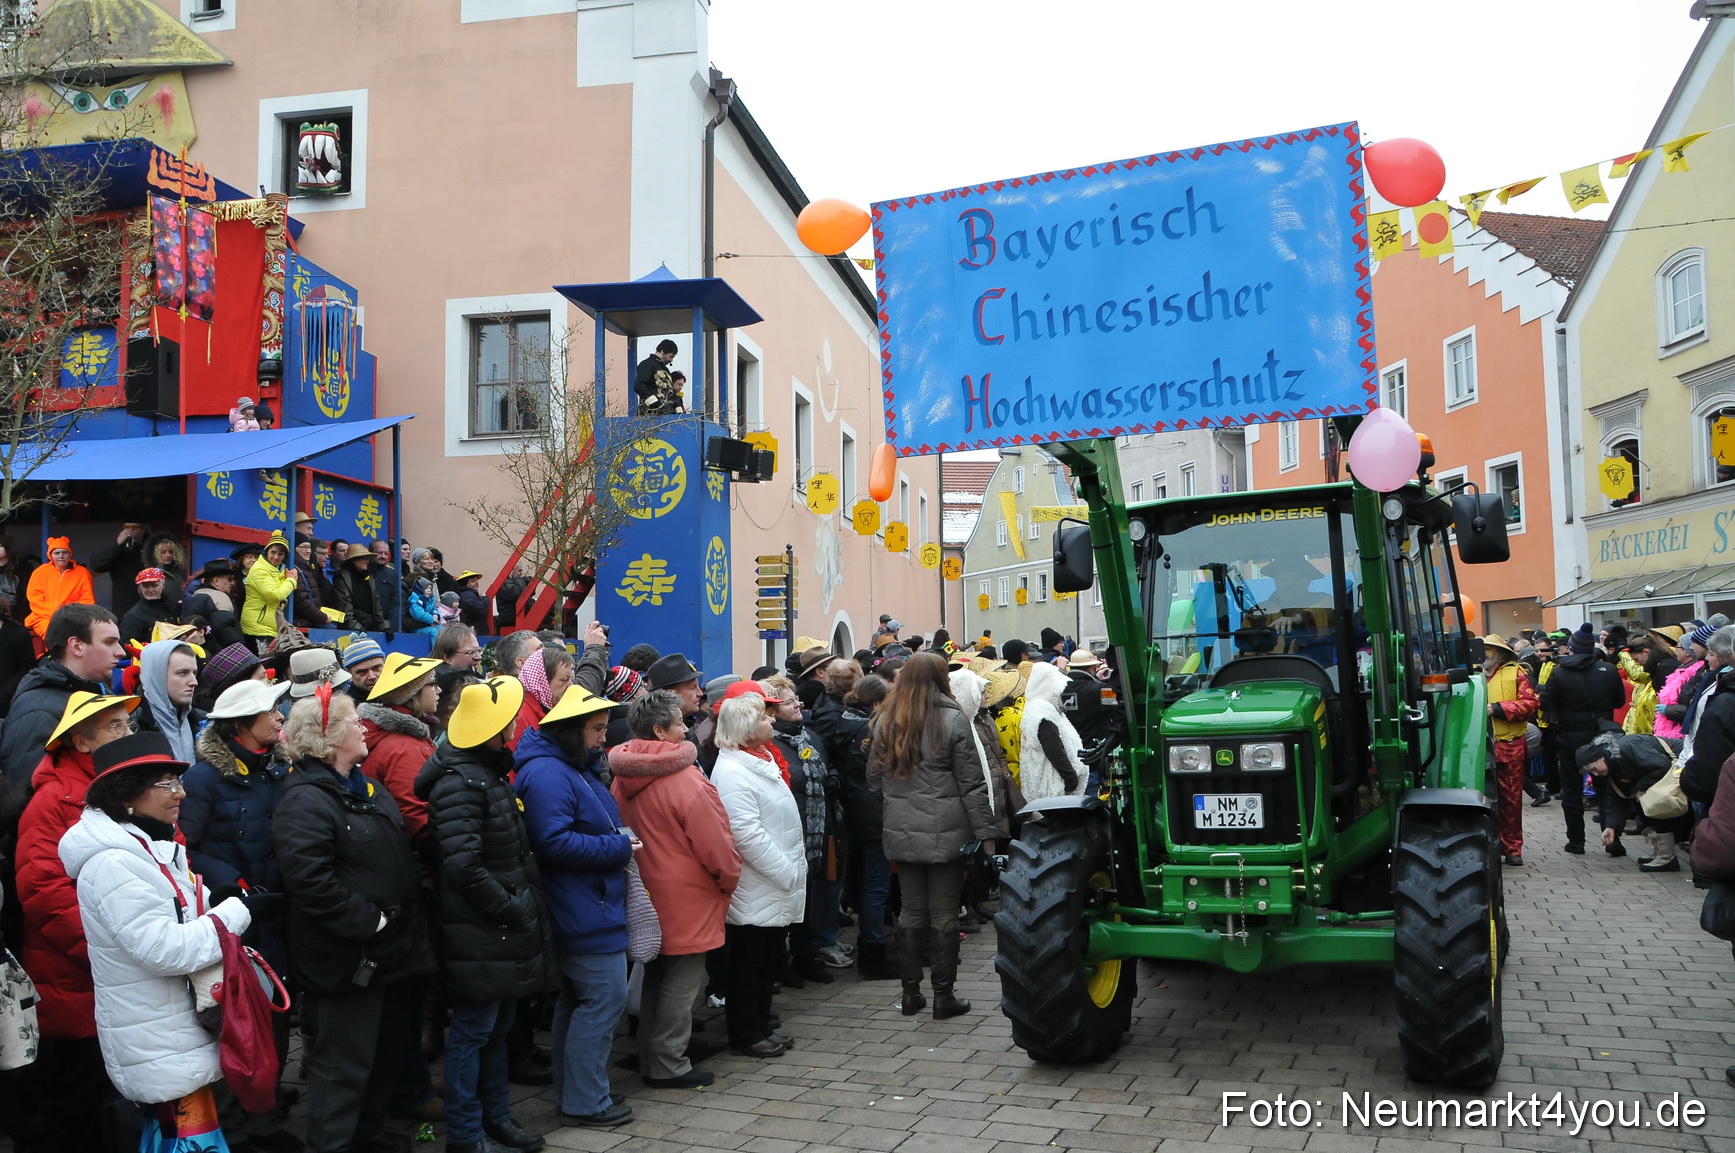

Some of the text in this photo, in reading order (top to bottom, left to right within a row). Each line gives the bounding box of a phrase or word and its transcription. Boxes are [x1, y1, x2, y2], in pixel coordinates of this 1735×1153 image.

[958, 186, 1227, 272] Bayerisch
[972, 270, 1274, 346] Chinesischer
[961, 349, 1306, 433] Hochwasserschutz
[1206, 506, 1325, 527] JOHN DEERE
[1600, 524, 1690, 563] BÄCKEREI
[1202, 813, 1257, 827] M 1234
[1217, 797, 1239, 811] NM
